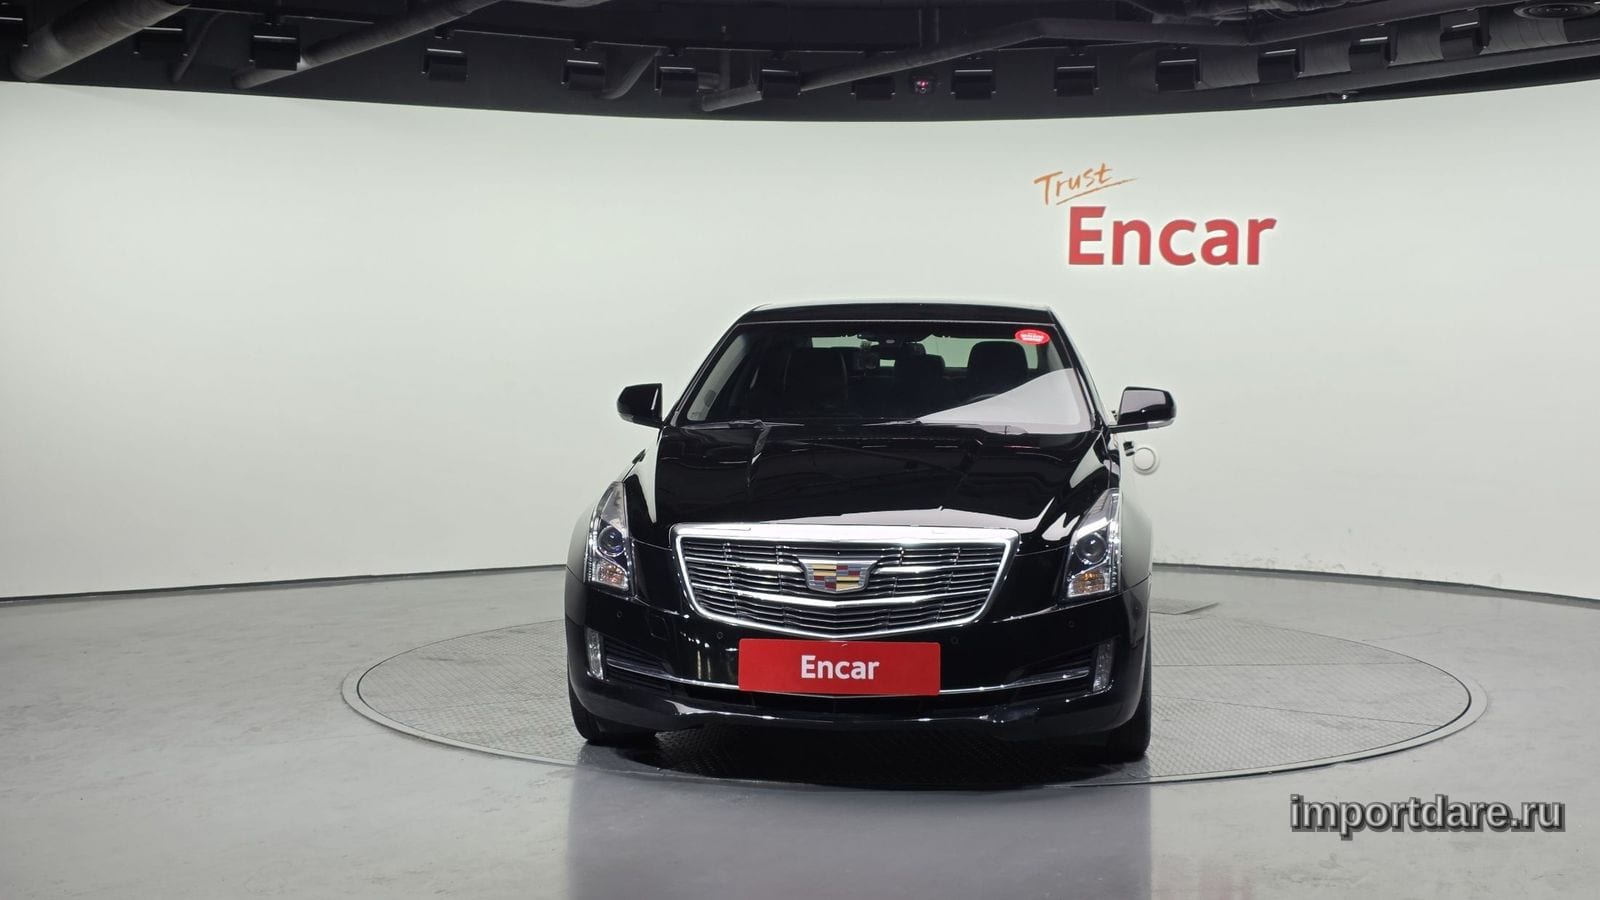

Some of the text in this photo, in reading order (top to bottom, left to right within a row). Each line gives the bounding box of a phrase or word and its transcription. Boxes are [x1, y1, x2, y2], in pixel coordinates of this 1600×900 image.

[1033, 163, 1113, 205] Trust
[1068, 206, 1277, 266] Encar
[801, 655, 880, 680] Encar
